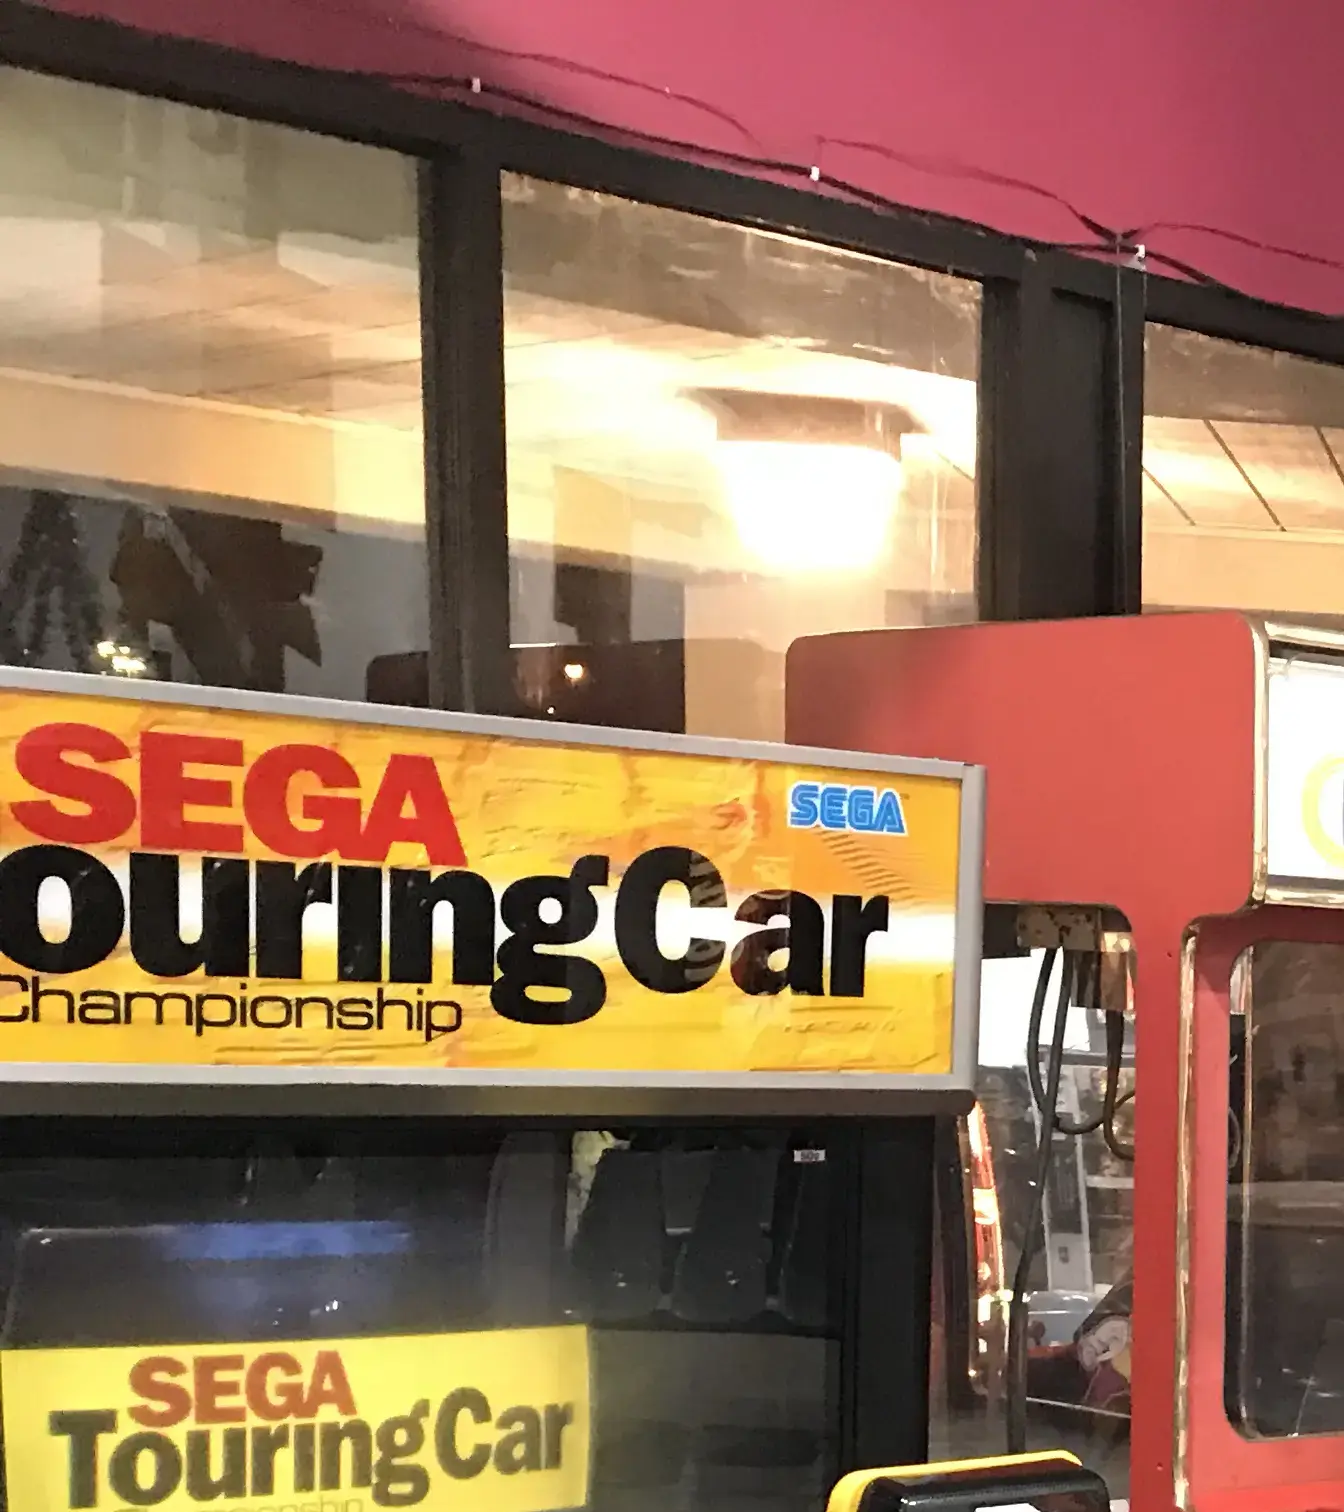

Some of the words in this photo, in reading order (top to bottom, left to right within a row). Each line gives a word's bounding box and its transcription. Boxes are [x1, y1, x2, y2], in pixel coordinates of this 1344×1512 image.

[11, 722, 467, 867] SEGA
[789, 784, 907, 834] SEGA
[0, 973, 462, 1041] Championship
[129, 1351, 357, 1426] SEGA
